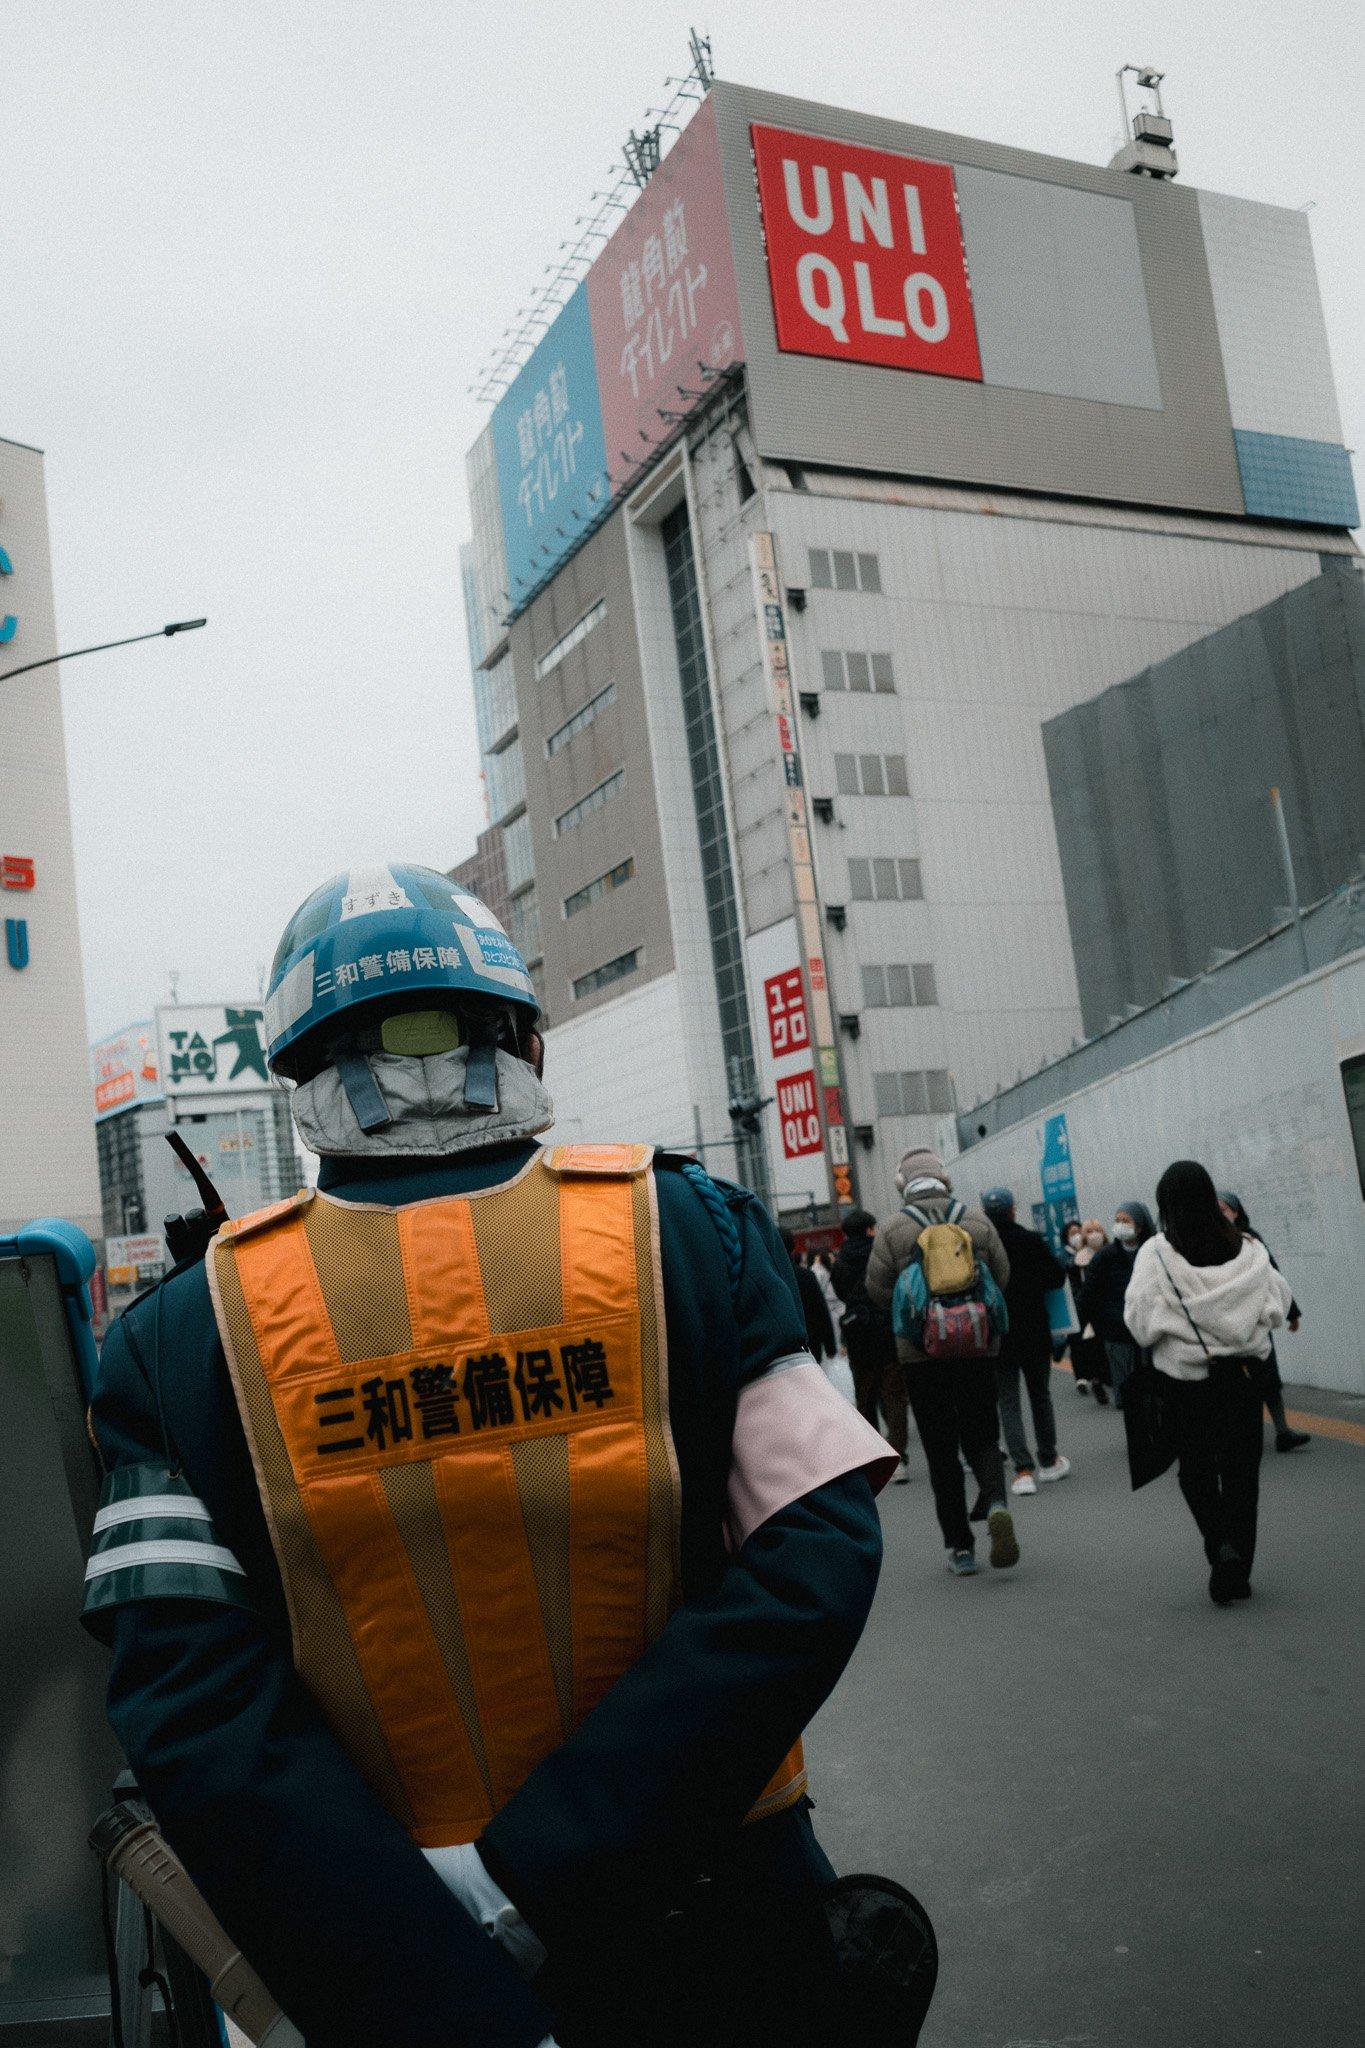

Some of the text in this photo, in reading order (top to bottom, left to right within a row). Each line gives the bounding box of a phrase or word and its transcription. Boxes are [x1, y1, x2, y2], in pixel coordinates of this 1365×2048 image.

[780, 157, 928, 256] UNI
[795, 252, 951, 344] QLO
[344, 891, 401, 913] すずき
[315, 946, 463, 998] 三和警備保障
[769, 976, 803, 1015] ユニ
[169, 1031, 208, 1050] TA
[773, 1011, 807, 1050] クロ
[170, 1052, 212, 1072] NO
[780, 1079, 814, 1116] UNI
[785, 1114, 820, 1154] QLO
[313, 1337, 614, 1456] 三和警備保障
